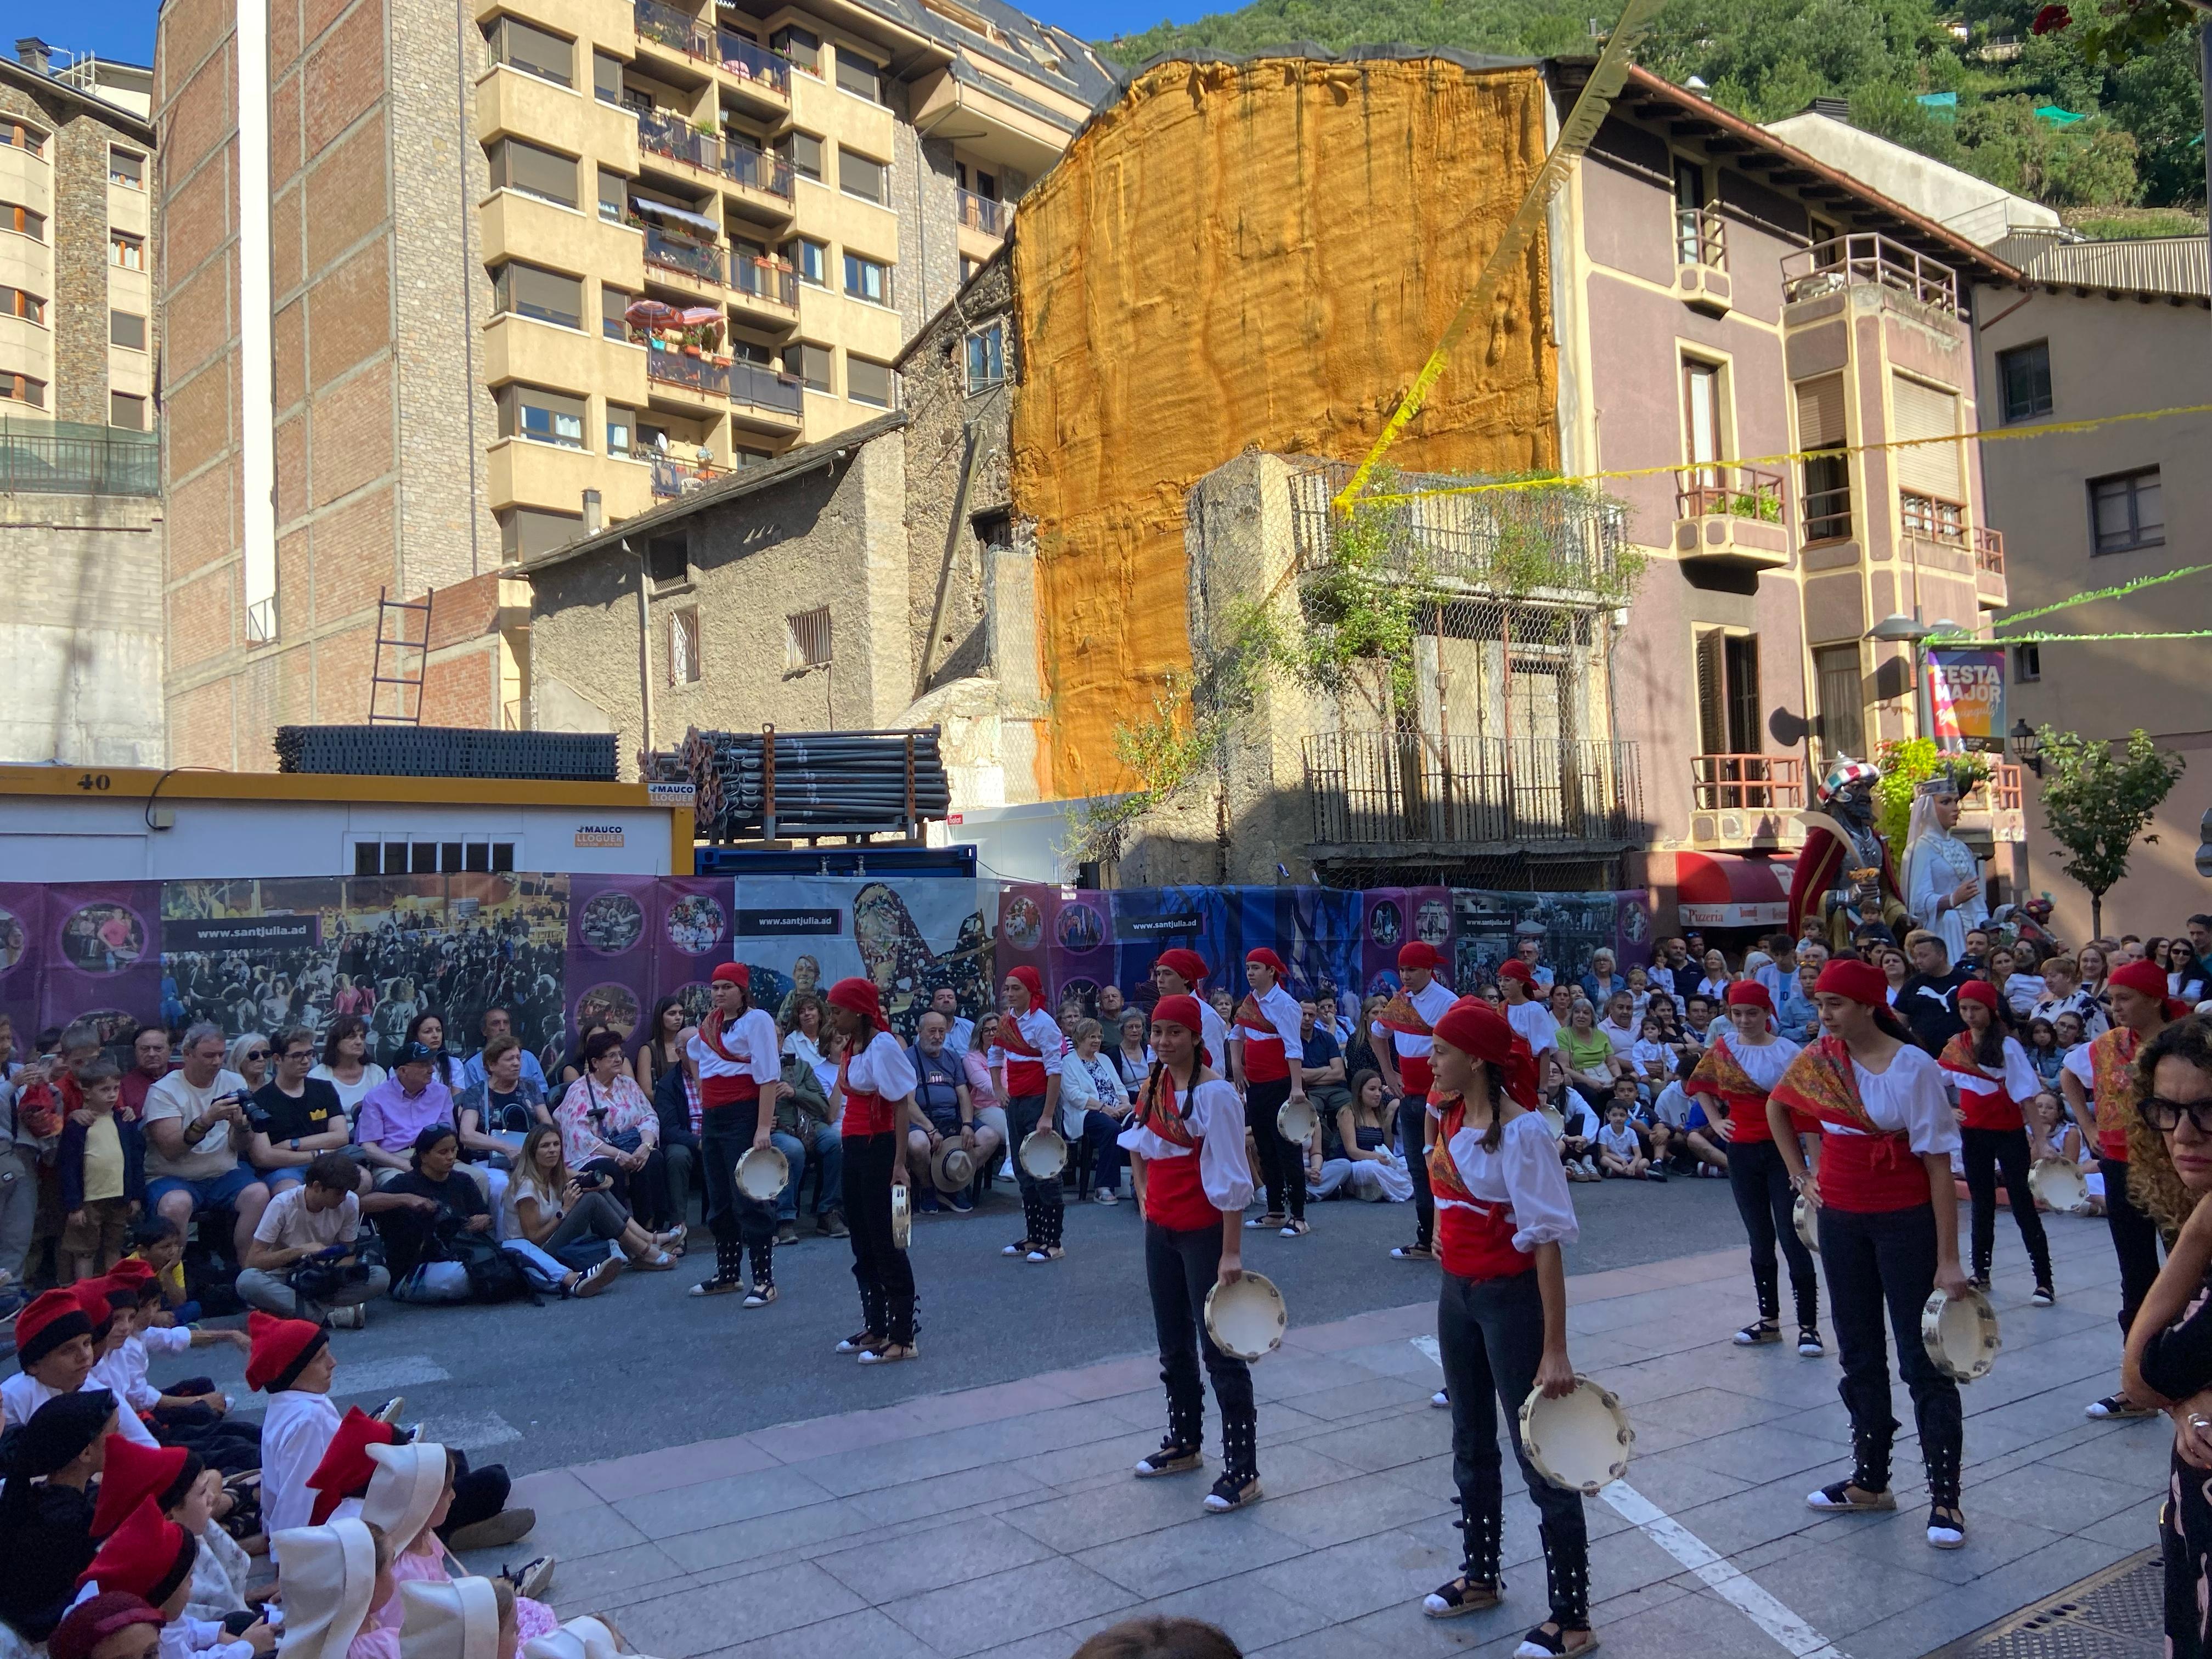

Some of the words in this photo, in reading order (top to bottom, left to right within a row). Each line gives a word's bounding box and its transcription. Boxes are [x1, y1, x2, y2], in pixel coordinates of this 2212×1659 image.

[1934, 664, 2001, 684] FESTA
[1935, 684, 2001, 703] MAJOR
[77, 774, 110, 791] 40
[658, 785, 693, 793] MAUCO
[759, 917, 832, 926] www.santjulia.ad
[1689, 909, 1724, 922] Pizzeria
[1132, 919, 1197, 929] www.santjulia.ad
[198, 925, 307, 938] www.santjulia.ad
